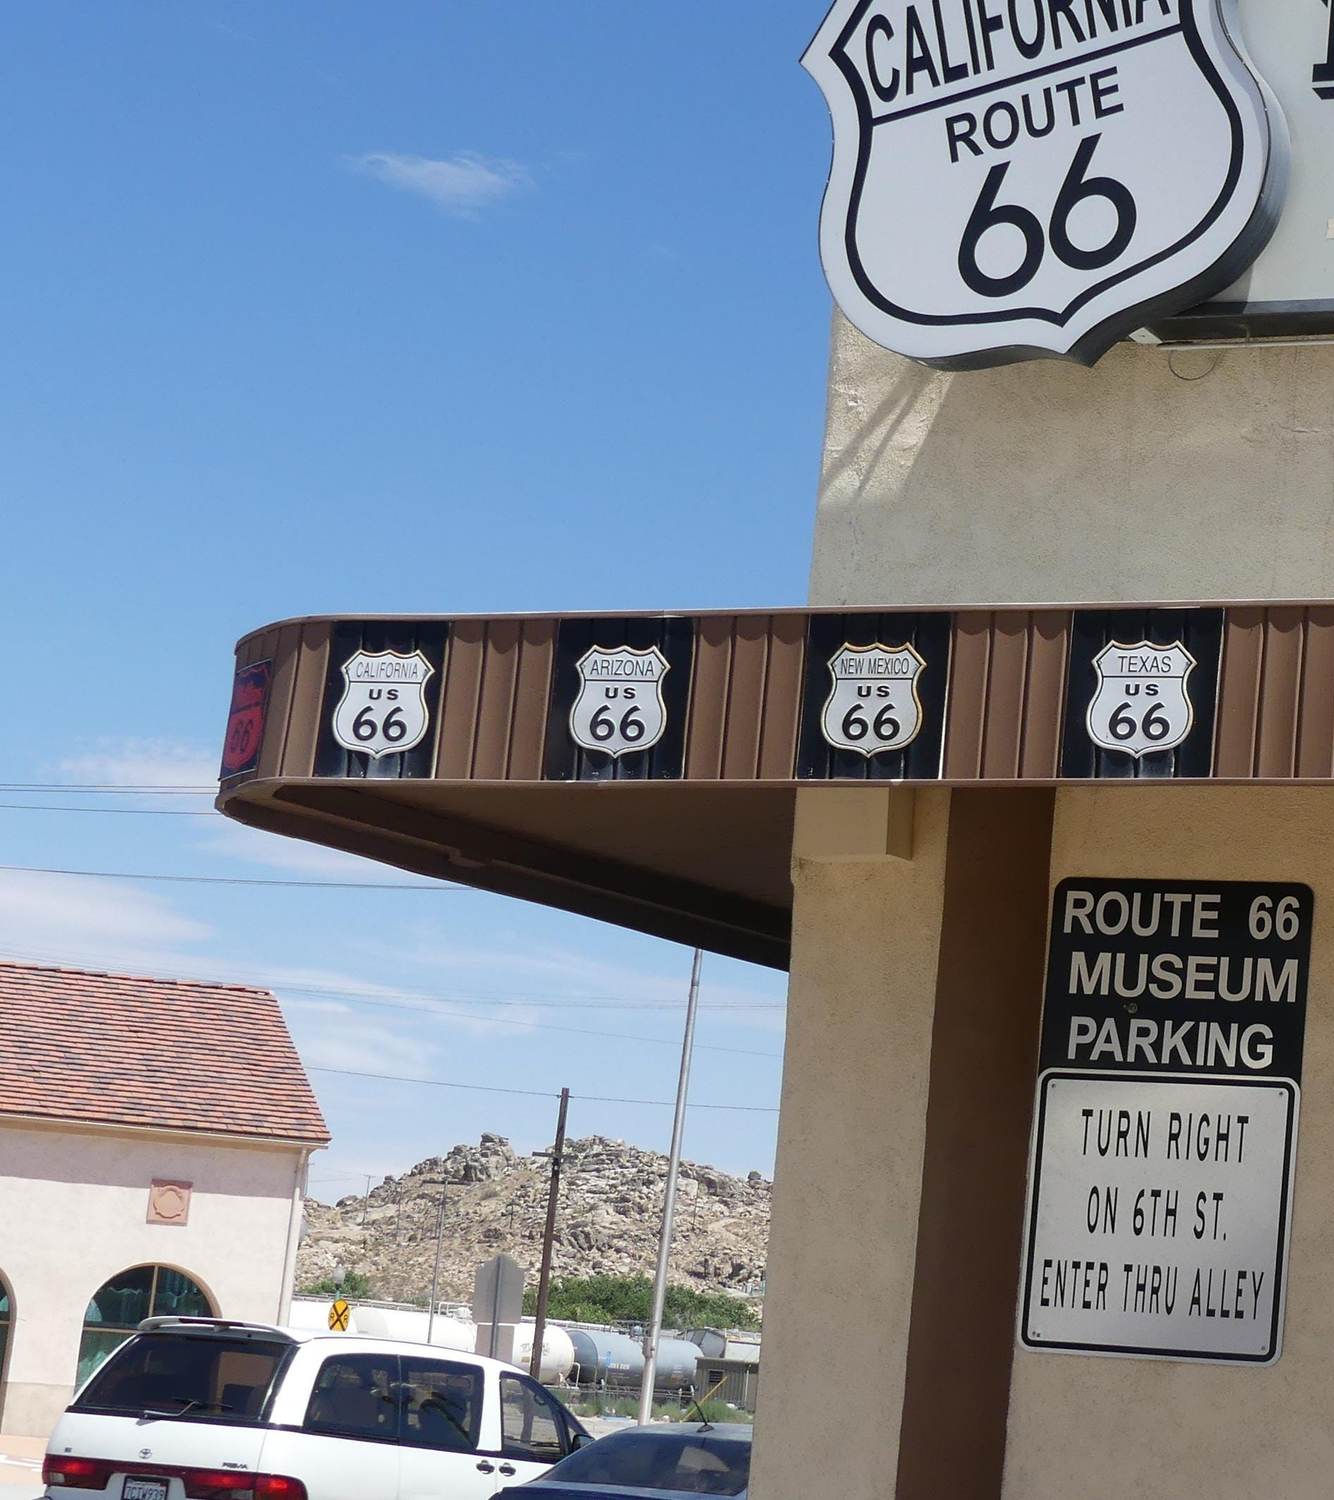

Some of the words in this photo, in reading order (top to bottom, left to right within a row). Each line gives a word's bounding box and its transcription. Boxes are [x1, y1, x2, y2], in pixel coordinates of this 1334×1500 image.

[866, 0, 1170, 102] CALIFOR
[945, 66, 1124, 163] ROUTE
[958, 133, 1137, 297] 66
[356, 661, 418, 681] CALIFORNIA
[590, 658, 655, 678] ARIZONA
[840, 657, 864, 676] NEW
[867, 656, 910, 675] MEXICO
[1117, 654, 1172, 673] TEXAS
[369, 688, 399, 701] US
[605, 686, 636, 700] US
[857, 684, 890, 698] US
[1125, 683, 1159, 696] US
[352, 706, 407, 742] 66
[589, 703, 646, 742] 66
[841, 702, 900, 741] 66
[1108, 701, 1171, 740] 66
[1063, 890, 1221, 938] ROUTE
[1248, 895, 1300, 941] 66
[1068, 951, 1299, 1003] MUSEUM
[1067, 1015, 1274, 1070] PARKING
[1082, 1108, 1150, 1158] TURN
[1167, 1112, 1249, 1163] RIGHT
[1087, 1185, 1118, 1234] ON
[1132, 1188, 1178, 1237] 6TH
[1193, 1191, 1226, 1241] ST.
[1040, 1259, 1109, 1310] ENTER
[1123, 1264, 1178, 1315] THRU
[1188, 1267, 1264, 1320] ALLEY
